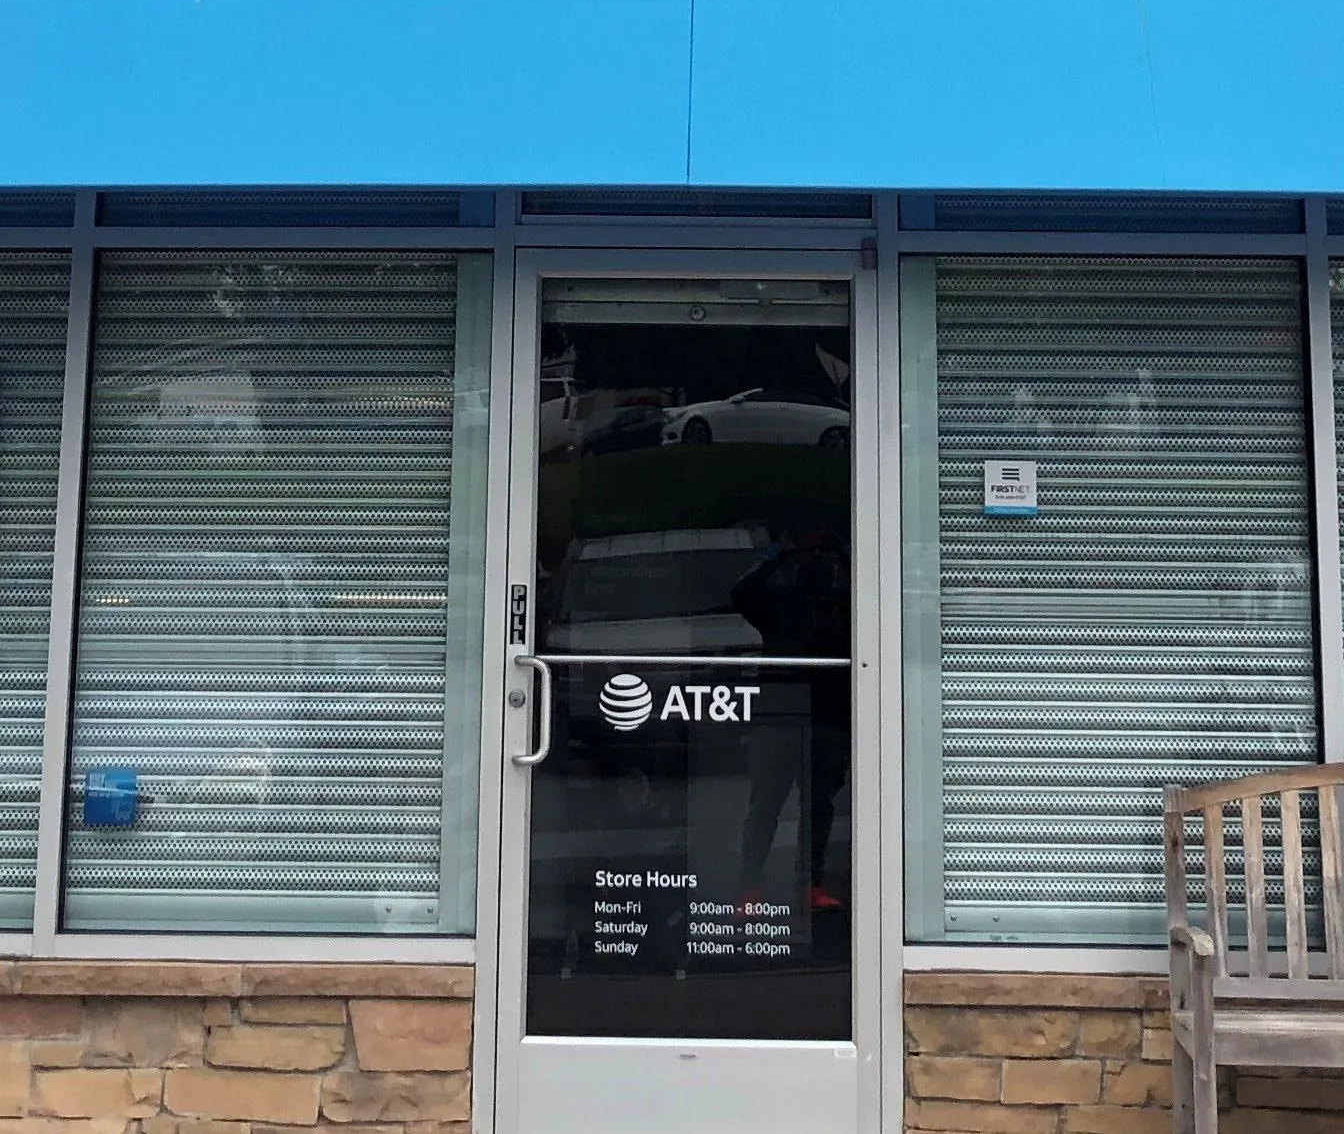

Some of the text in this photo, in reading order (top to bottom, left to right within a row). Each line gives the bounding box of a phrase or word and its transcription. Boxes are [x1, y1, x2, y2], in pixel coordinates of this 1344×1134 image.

[512, 585, 526, 645] PULL
[659, 685, 761, 722] AT&T
[595, 870, 698, 888] Store Hours
[594, 901, 642, 914] Mon-Fri
[689, 902, 734, 915] 9:00am
[744, 902, 791, 917] 8:00pm
[594, 921, 649, 937] Saturday
[689, 922, 734, 935] 9:00am
[744, 922, 791, 939] 8:00pm
[594, 940, 639, 956] Sunday
[744, 941, 791, 958] 6:00pm
